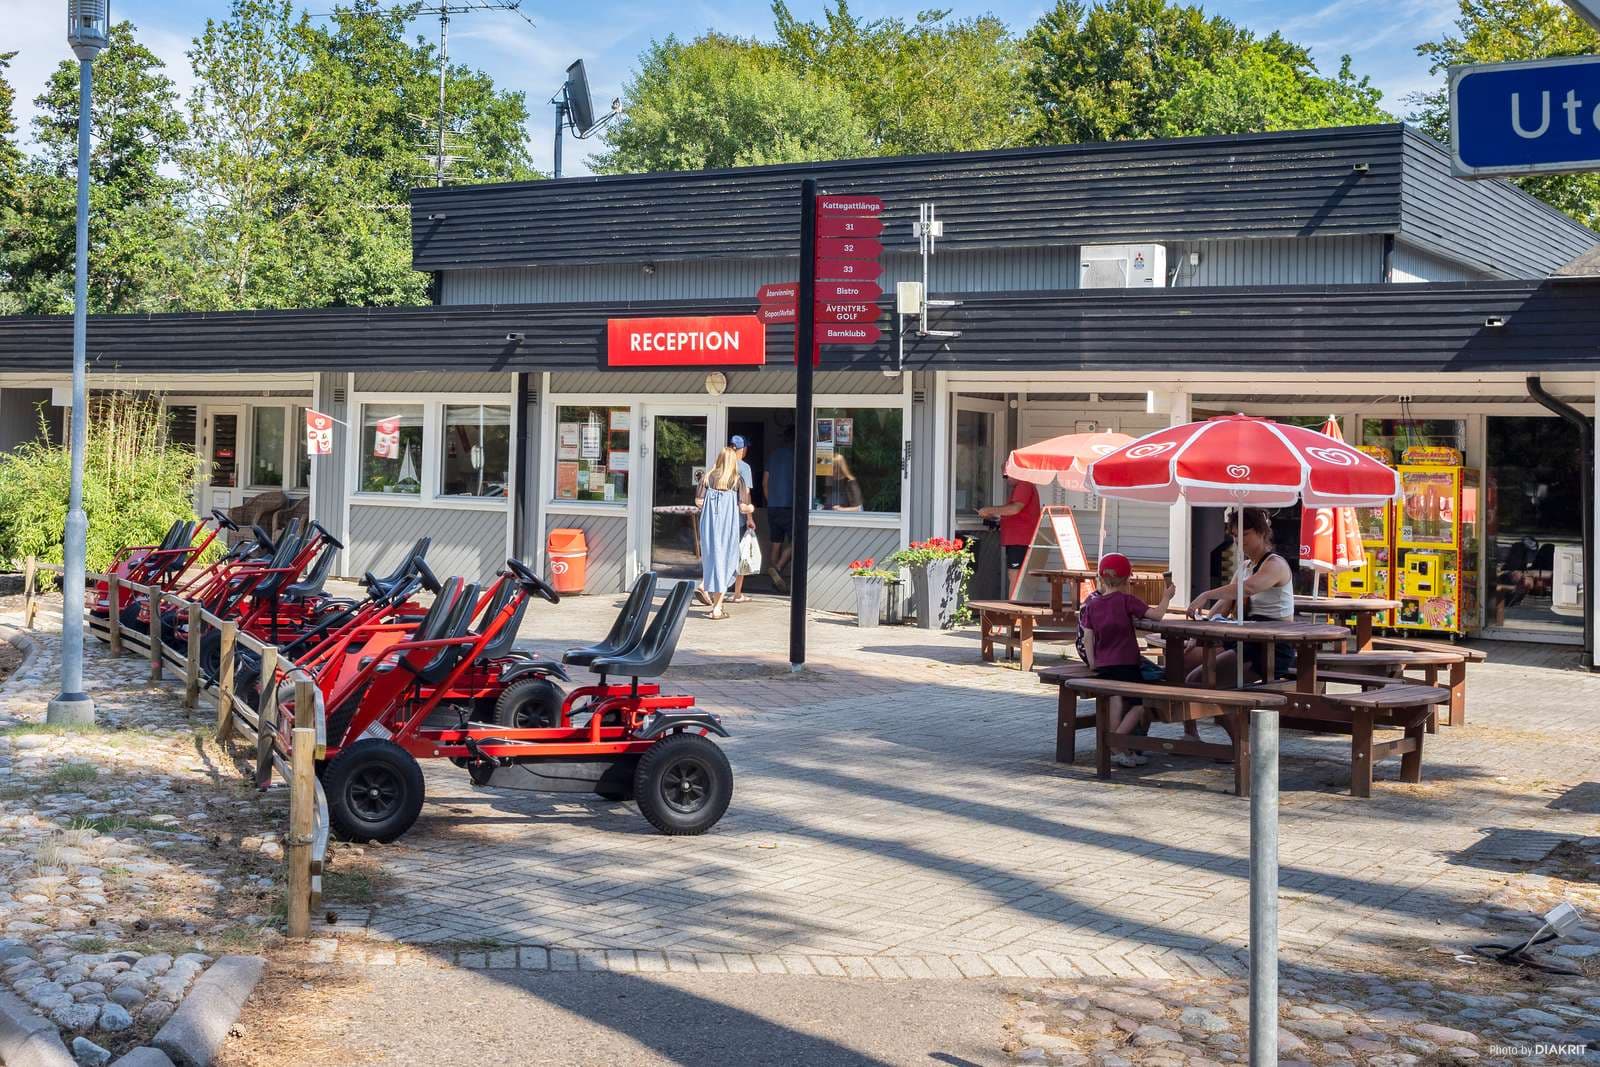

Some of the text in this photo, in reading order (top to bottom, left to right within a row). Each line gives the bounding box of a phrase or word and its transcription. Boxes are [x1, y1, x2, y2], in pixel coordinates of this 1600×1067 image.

[822, 201, 880, 211] Kattegattlänga
[845, 223, 854, 231] 31
[844, 244, 854, 252] 32
[843, 265, 853, 273] 33
[836, 287, 859, 296] Bistro
[826, 304, 868, 313] ÄVENTYRS-
[836, 313, 858, 321] GOLF
[827, 328, 866, 337] Barnklubb
[630, 331, 739, 351] RECEPTION
